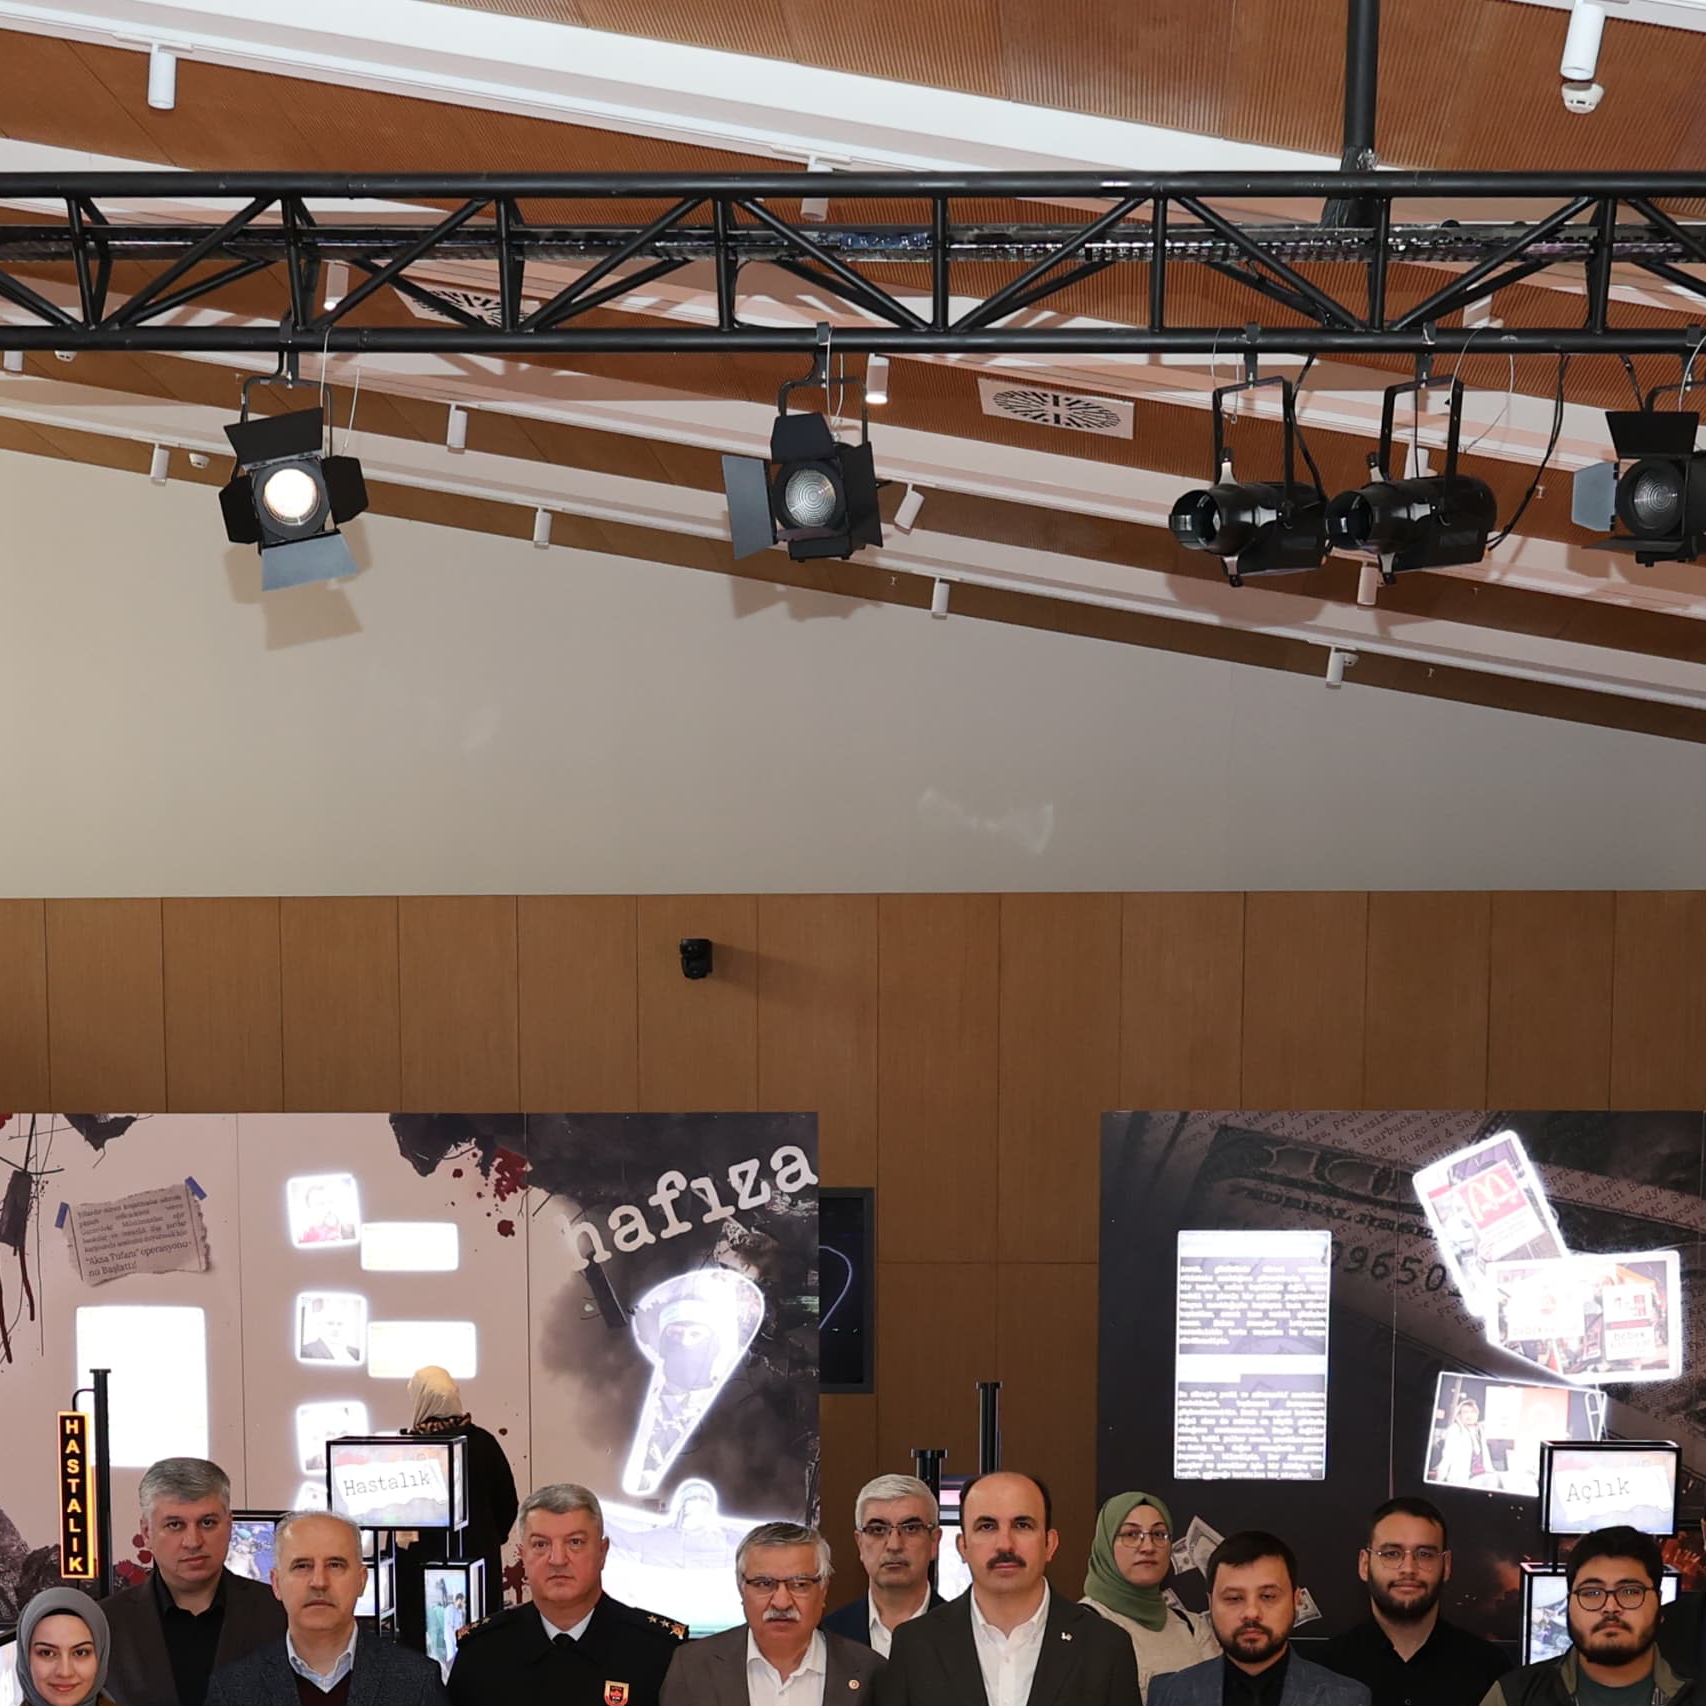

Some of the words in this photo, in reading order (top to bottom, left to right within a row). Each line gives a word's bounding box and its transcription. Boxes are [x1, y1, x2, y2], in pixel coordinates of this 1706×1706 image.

[1360, 1110, 1423, 1150] Starbucks,
[1397, 1123, 1429, 1147] Hugo
[560, 1144, 818, 1271] hafıza
[65, 1418, 84, 1574] HASTALIK
[343, 1470, 431, 1497] Hastalık
[1566, 1477, 1631, 1504] Açlık
